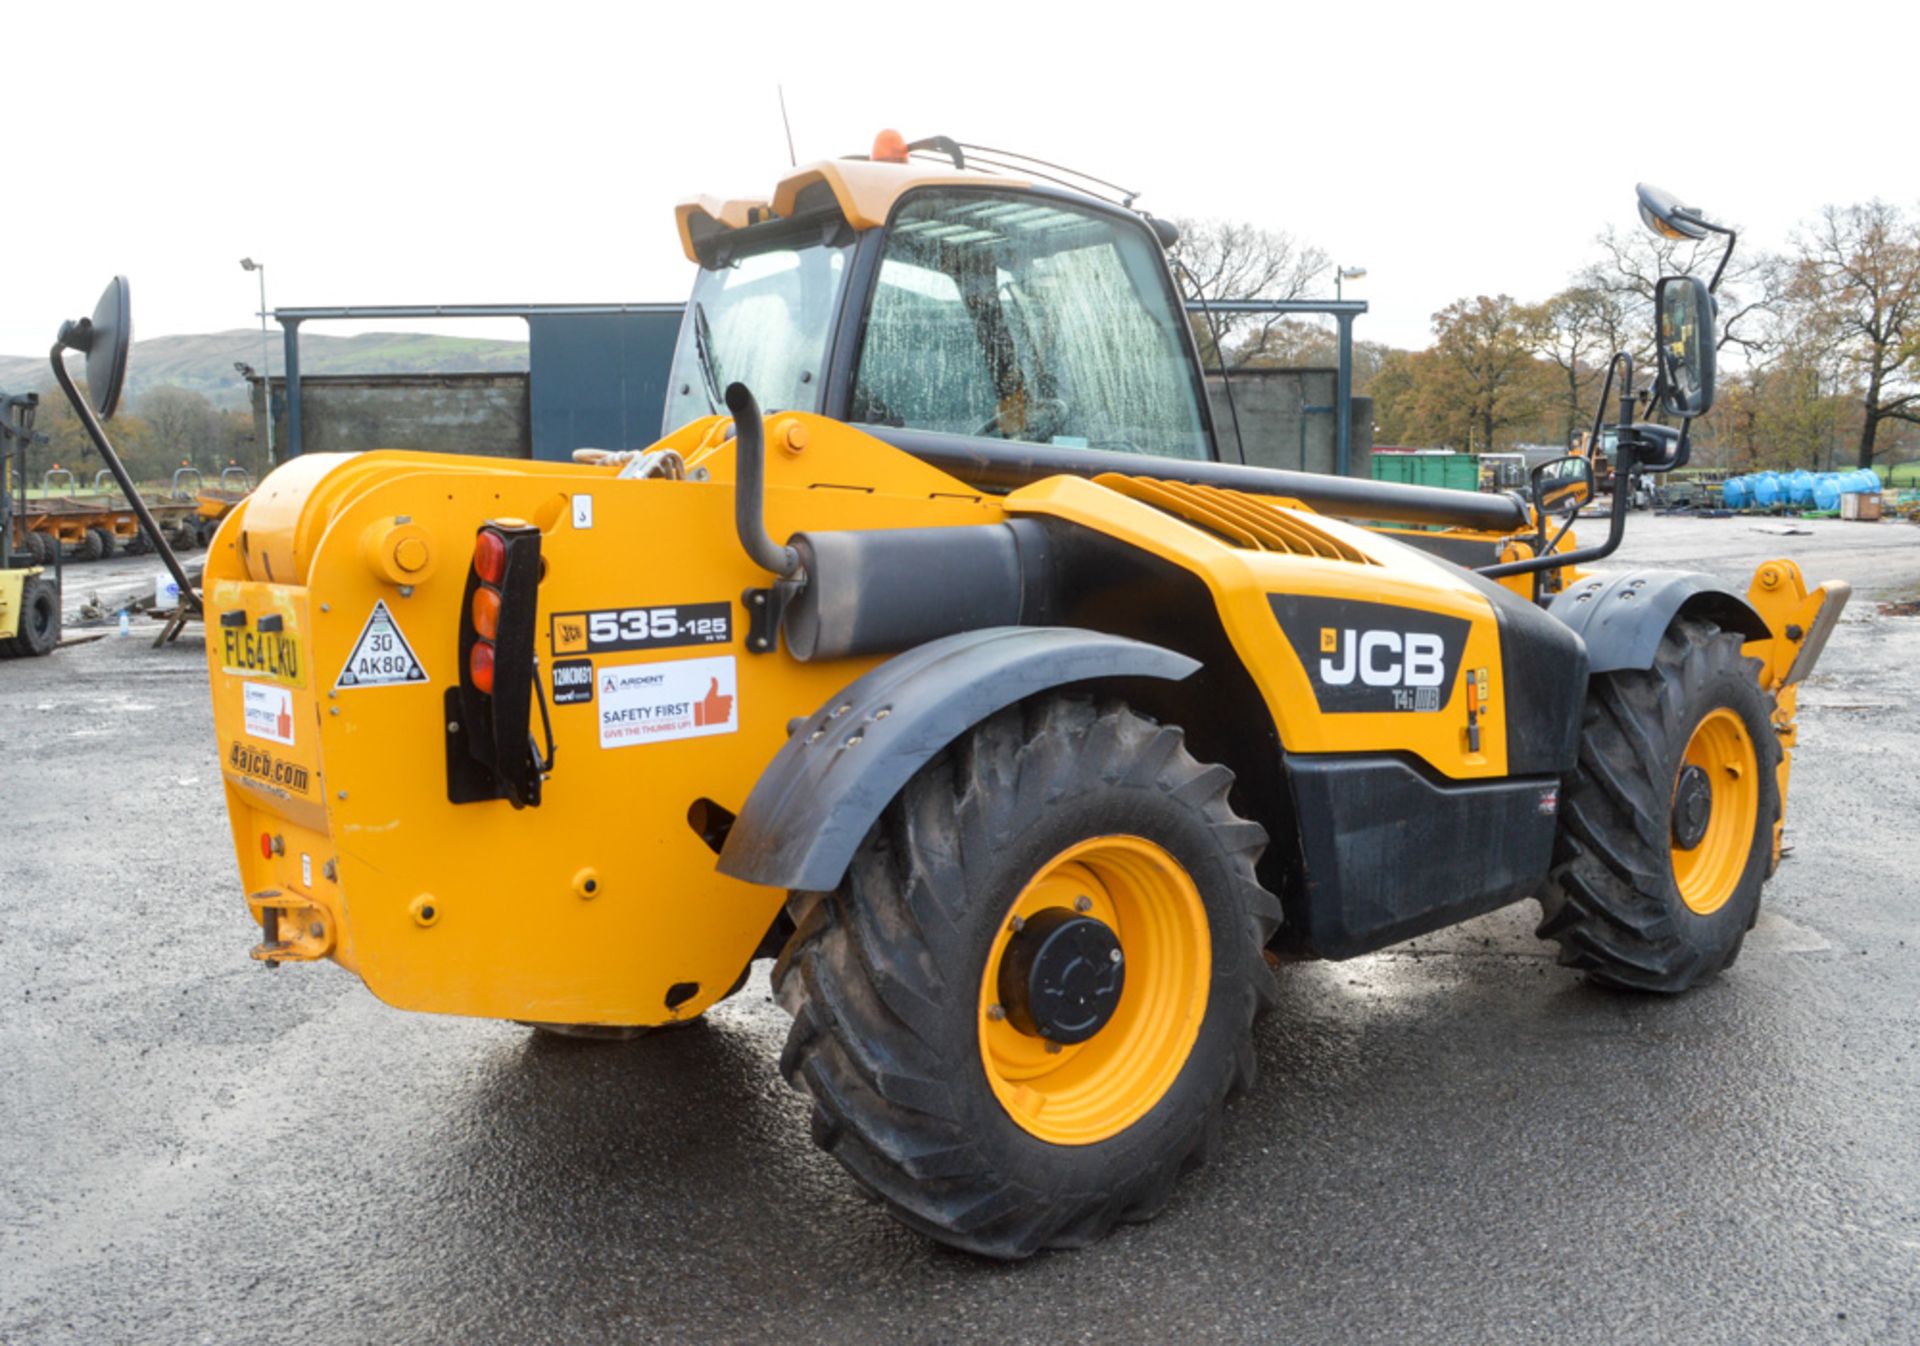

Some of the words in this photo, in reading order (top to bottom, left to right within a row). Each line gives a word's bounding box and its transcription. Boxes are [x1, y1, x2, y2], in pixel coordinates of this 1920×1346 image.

[224, 629, 266, 672] FL64
[370, 633, 393, 652] 30
[359, 655, 406, 676] AK8Q
[1320, 629, 1445, 686] JCB
[620, 675, 664, 686] ARDENT
[603, 707, 652, 724] SAFETY
[655, 702, 690, 718] FIRST
[604, 728, 623, 740] GIVE
[625, 726, 640, 736] THE
[642, 722, 677, 734] THUMBS
[231, 743, 309, 793] 4ajcb.com
